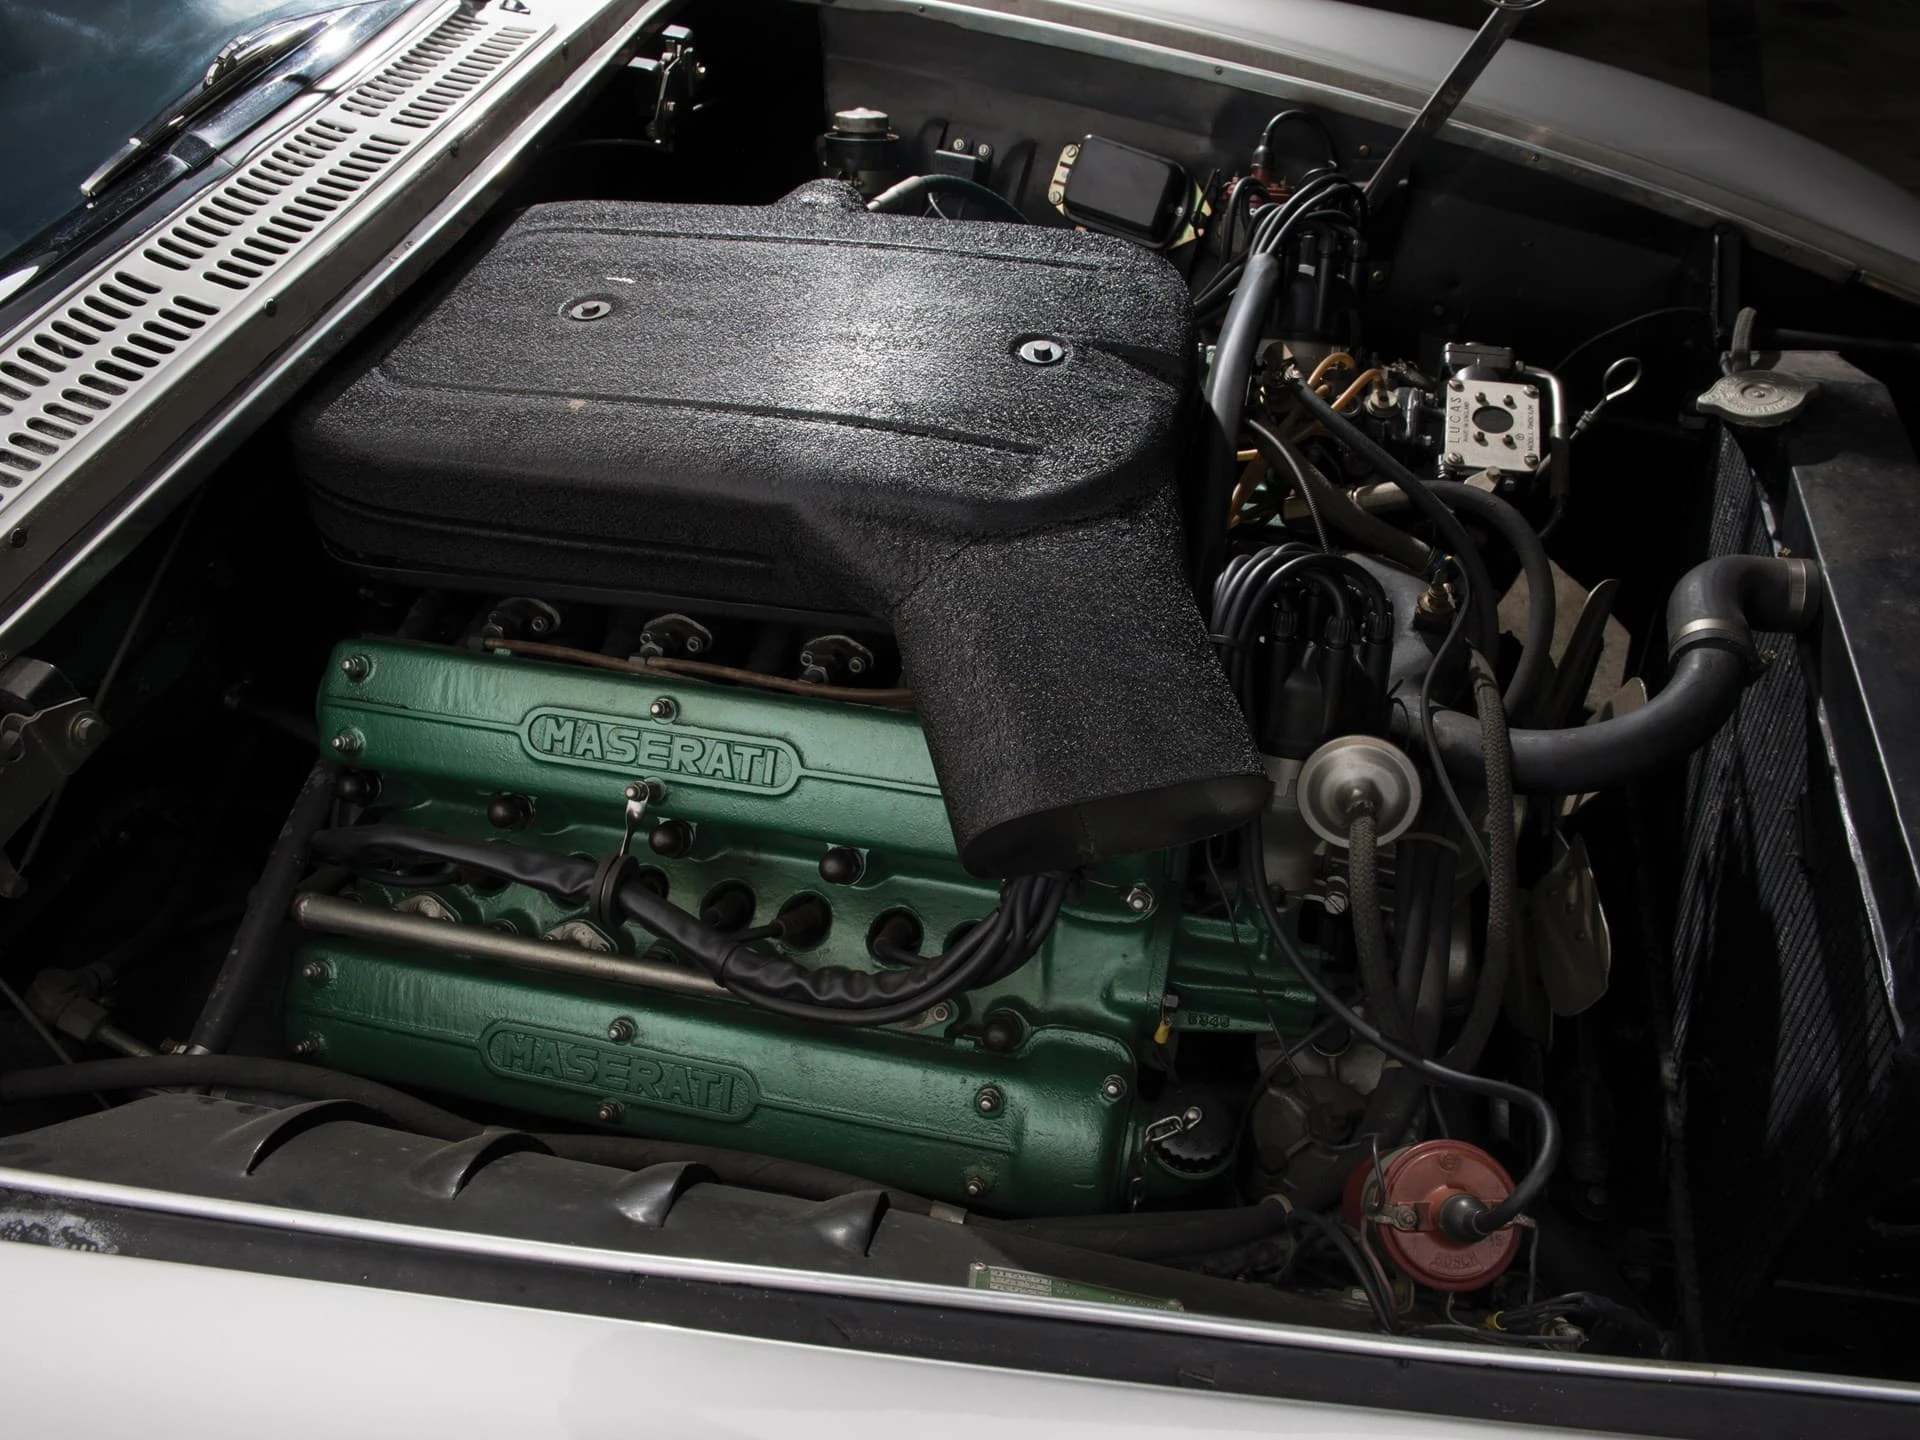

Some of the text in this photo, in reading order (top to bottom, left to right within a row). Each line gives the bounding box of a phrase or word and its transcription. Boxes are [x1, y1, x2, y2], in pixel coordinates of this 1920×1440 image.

[1449, 396, 1462, 444] LUCAS
[542, 716, 777, 785] MASERATI
[502, 1034, 736, 1113] MASERATI
